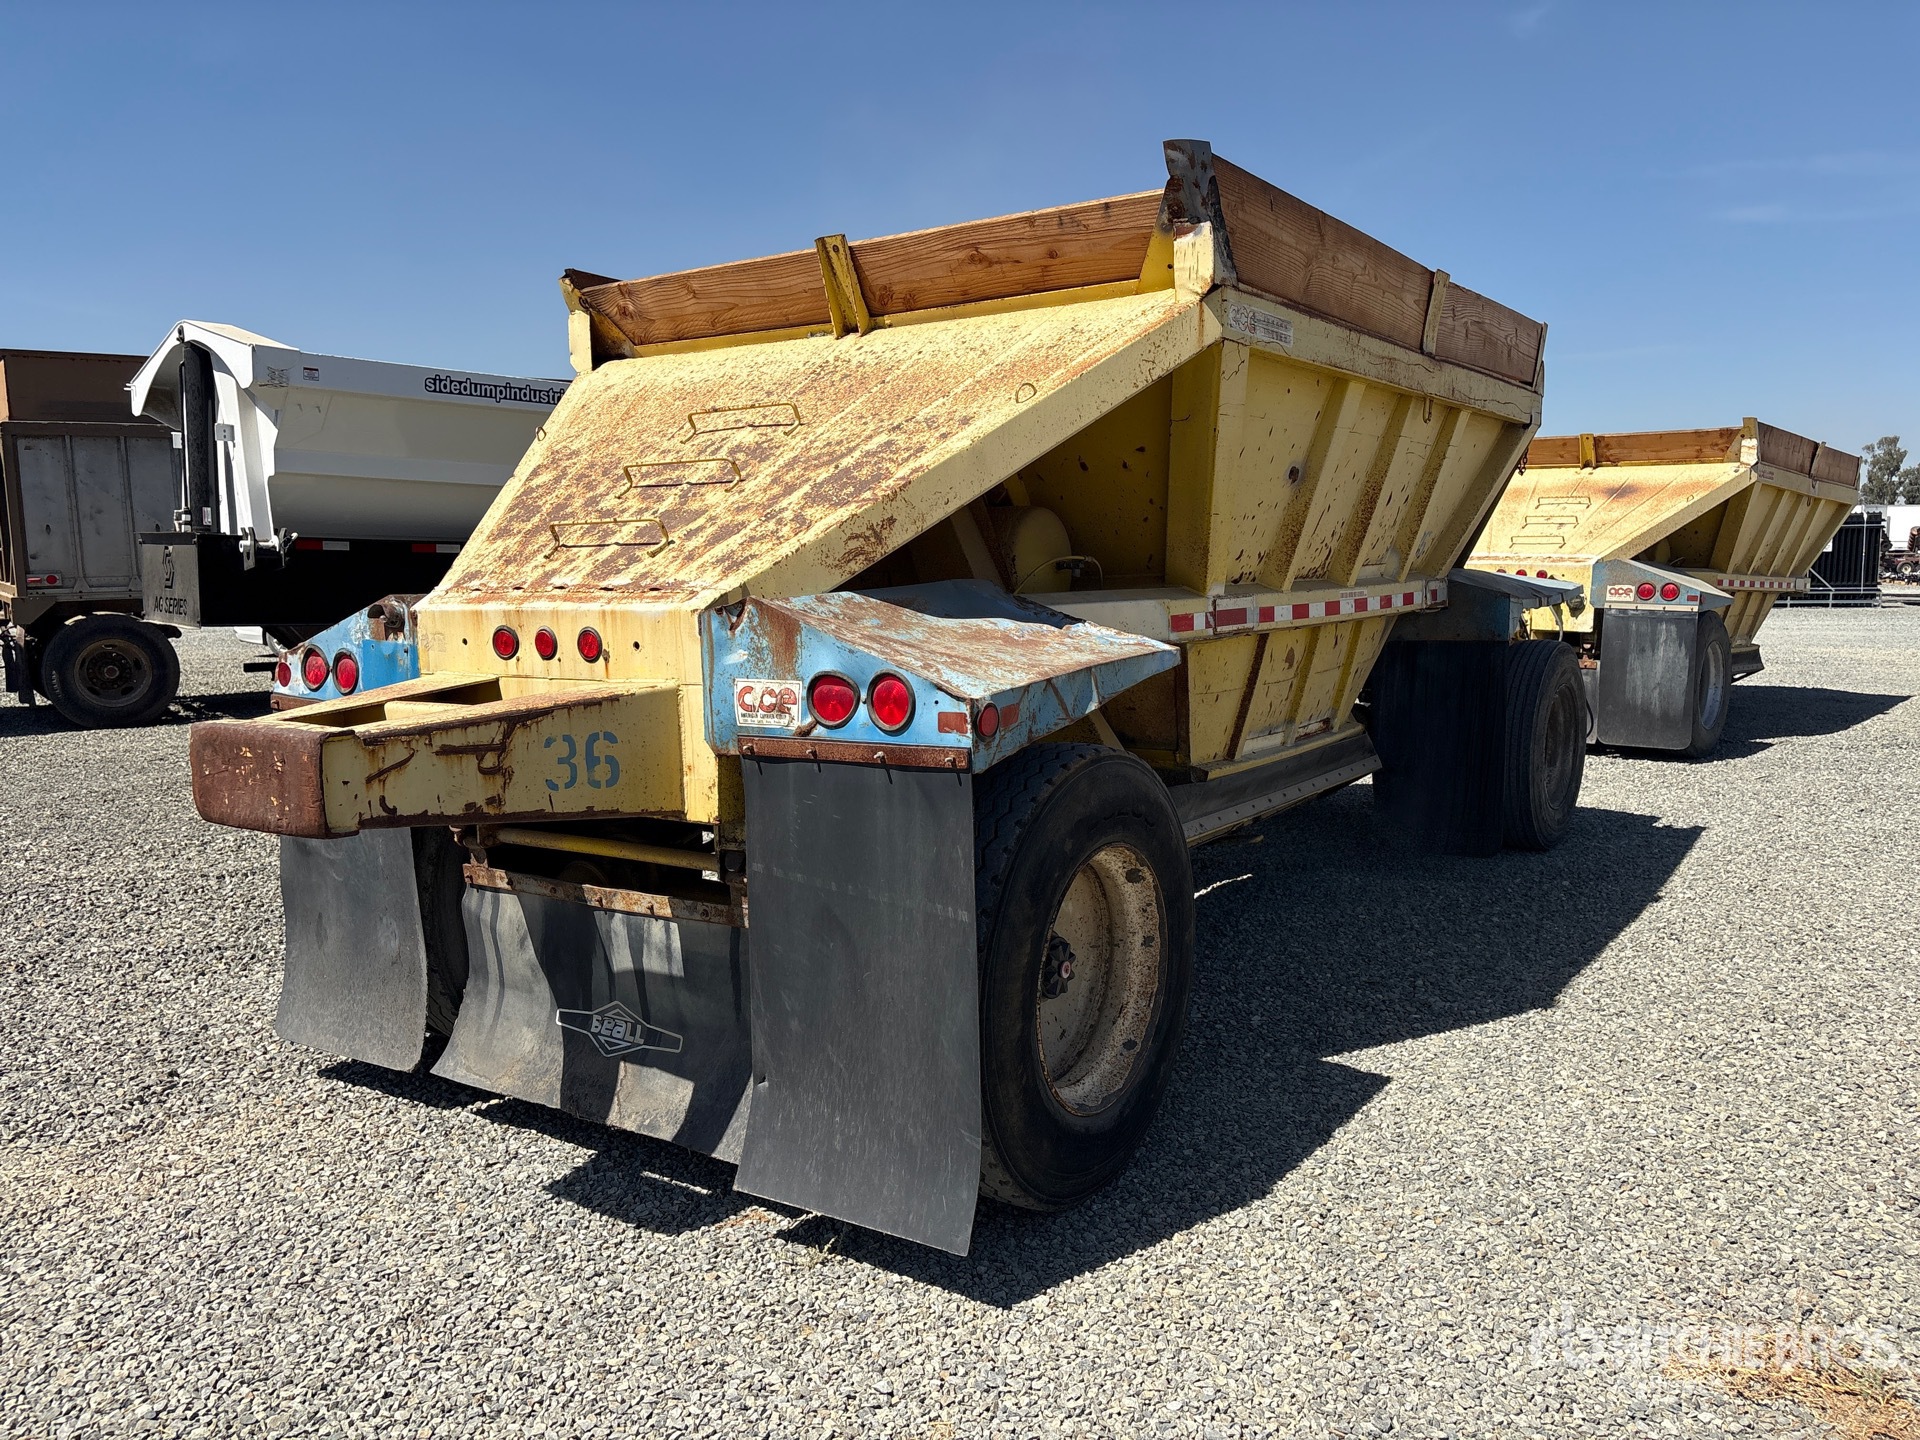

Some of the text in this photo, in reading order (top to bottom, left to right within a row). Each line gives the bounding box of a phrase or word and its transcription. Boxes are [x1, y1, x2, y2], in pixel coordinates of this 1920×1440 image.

[154, 596, 188, 616] AG SERIES
[544, 731, 620, 791] 36
